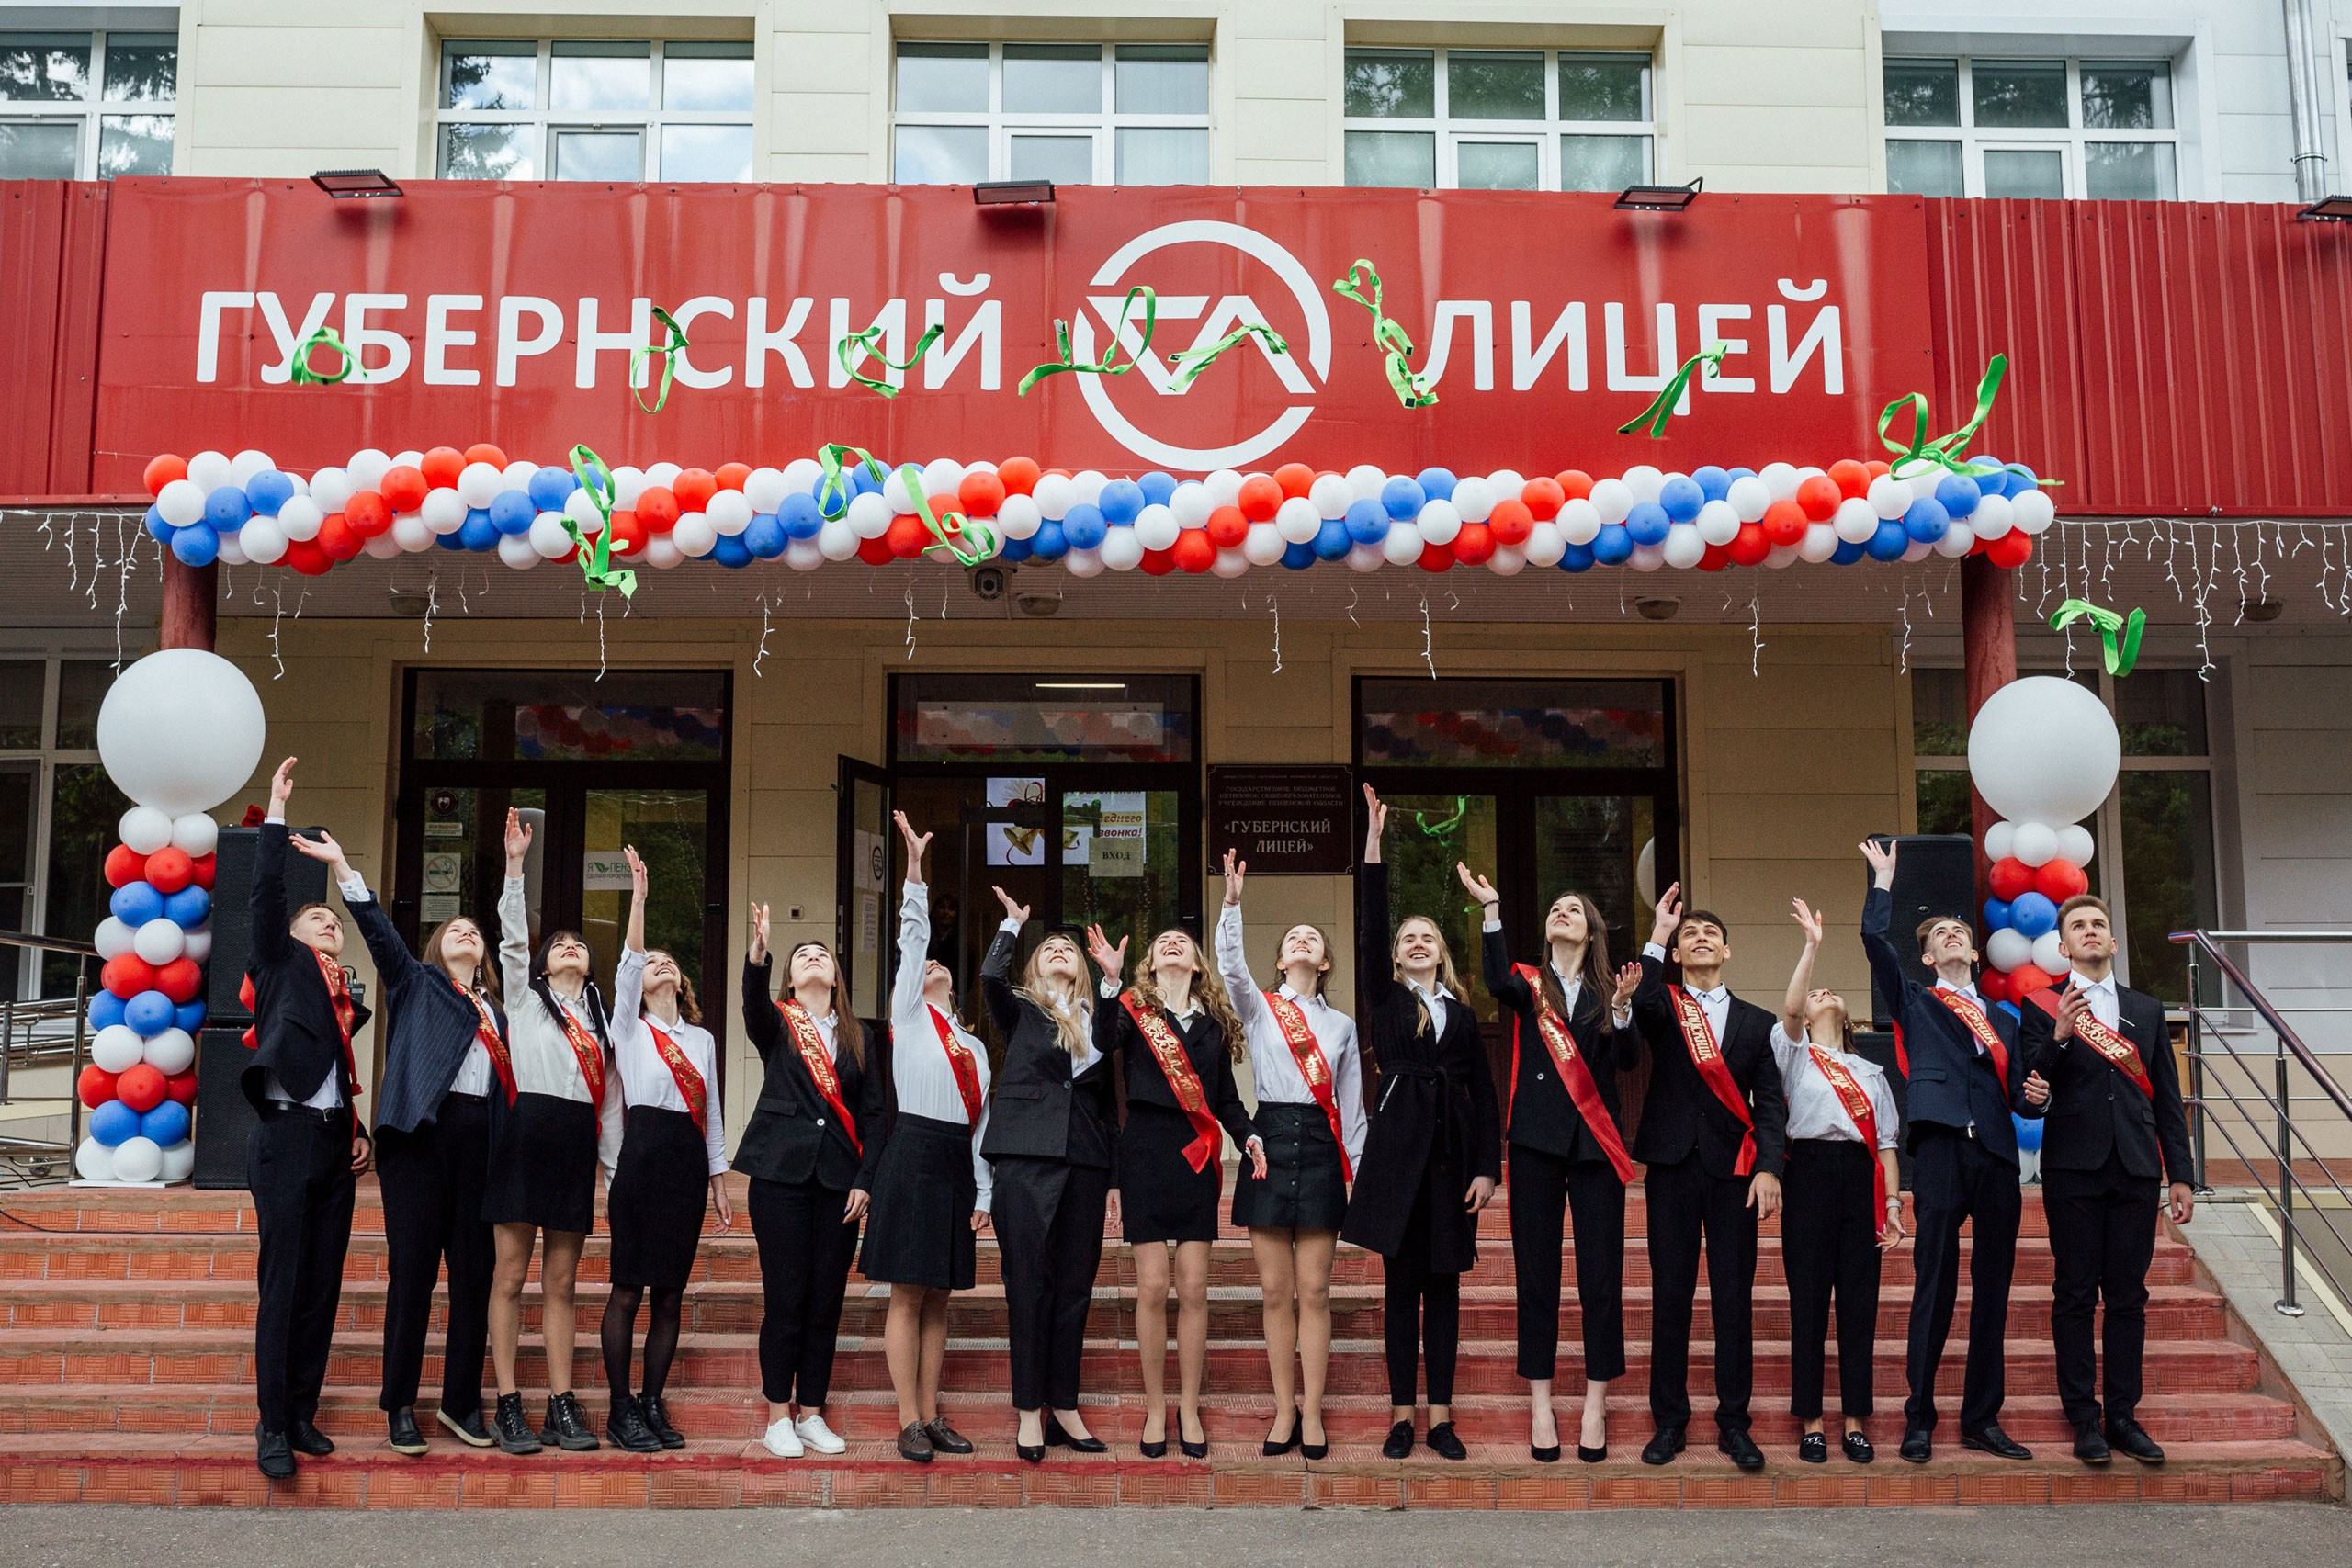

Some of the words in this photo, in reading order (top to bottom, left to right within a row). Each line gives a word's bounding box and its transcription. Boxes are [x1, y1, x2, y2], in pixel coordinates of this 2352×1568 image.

[196, 272, 1002, 392] ГУБЕРНСКИЙ
[1413, 278, 1845, 416] ЛИЦЕЙ
[1224, 818, 1331, 833] «ГУБЕРНСКИЙ
[1256, 839, 1314, 854] ЛИЦЕЙ»
[1102, 852, 1131, 861] ВХОД
[610, 862, 632, 873] ПЕНЗ
